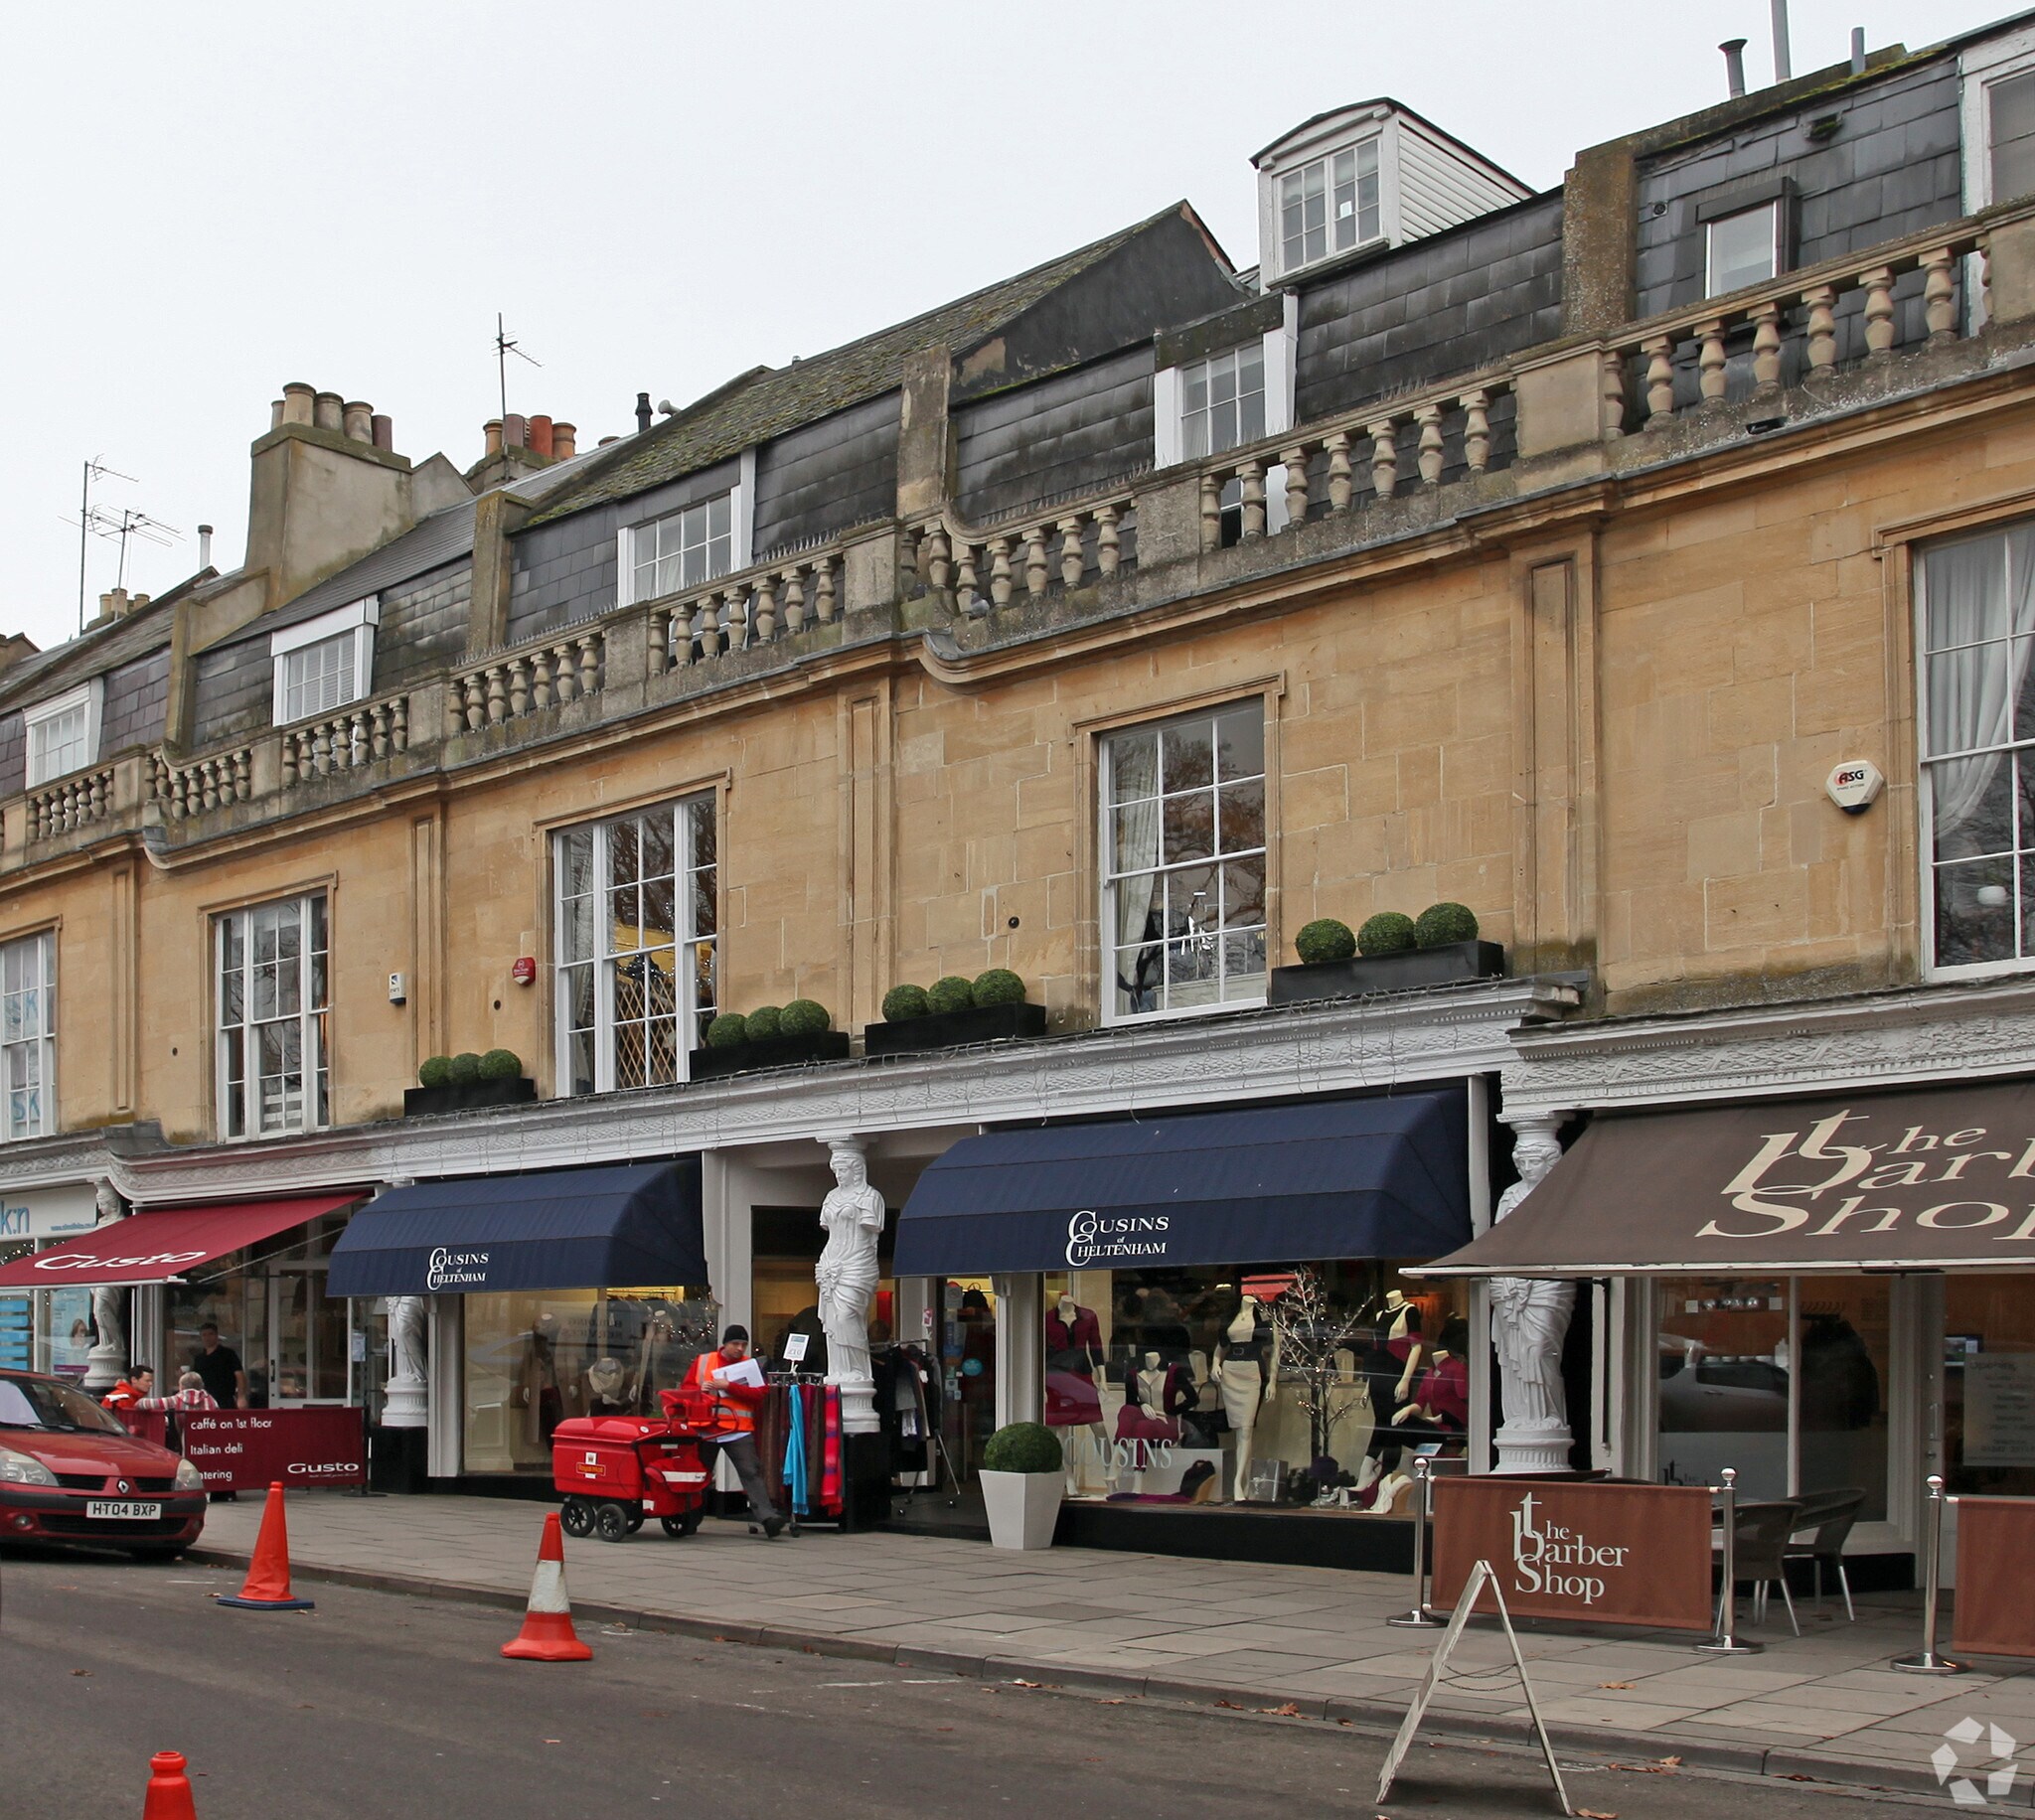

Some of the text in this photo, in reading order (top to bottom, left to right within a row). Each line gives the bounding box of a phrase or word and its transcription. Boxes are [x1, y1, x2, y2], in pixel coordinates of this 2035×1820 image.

[1838, 769, 1864, 785] ASG
[1068, 1210, 1170, 1243] COUSINS
[429, 1247, 489, 1273] COUSINS
[1065, 1234, 1167, 1267] CHELTENHAM
[34, 1251, 207, 1271] Gusto
[426, 1265, 487, 1290] CHELTENHAM
[190, 1417, 217, 1431] caffé
[235, 1418, 247, 1430] 1st
[250, 1417, 272, 1429] floor
[190, 1442, 243, 1455] Italian deli
[287, 1462, 360, 1474] Gusto
[92, 1503, 157, 1516] HT04 BXP
[1515, 1554, 1605, 1604] Shop
